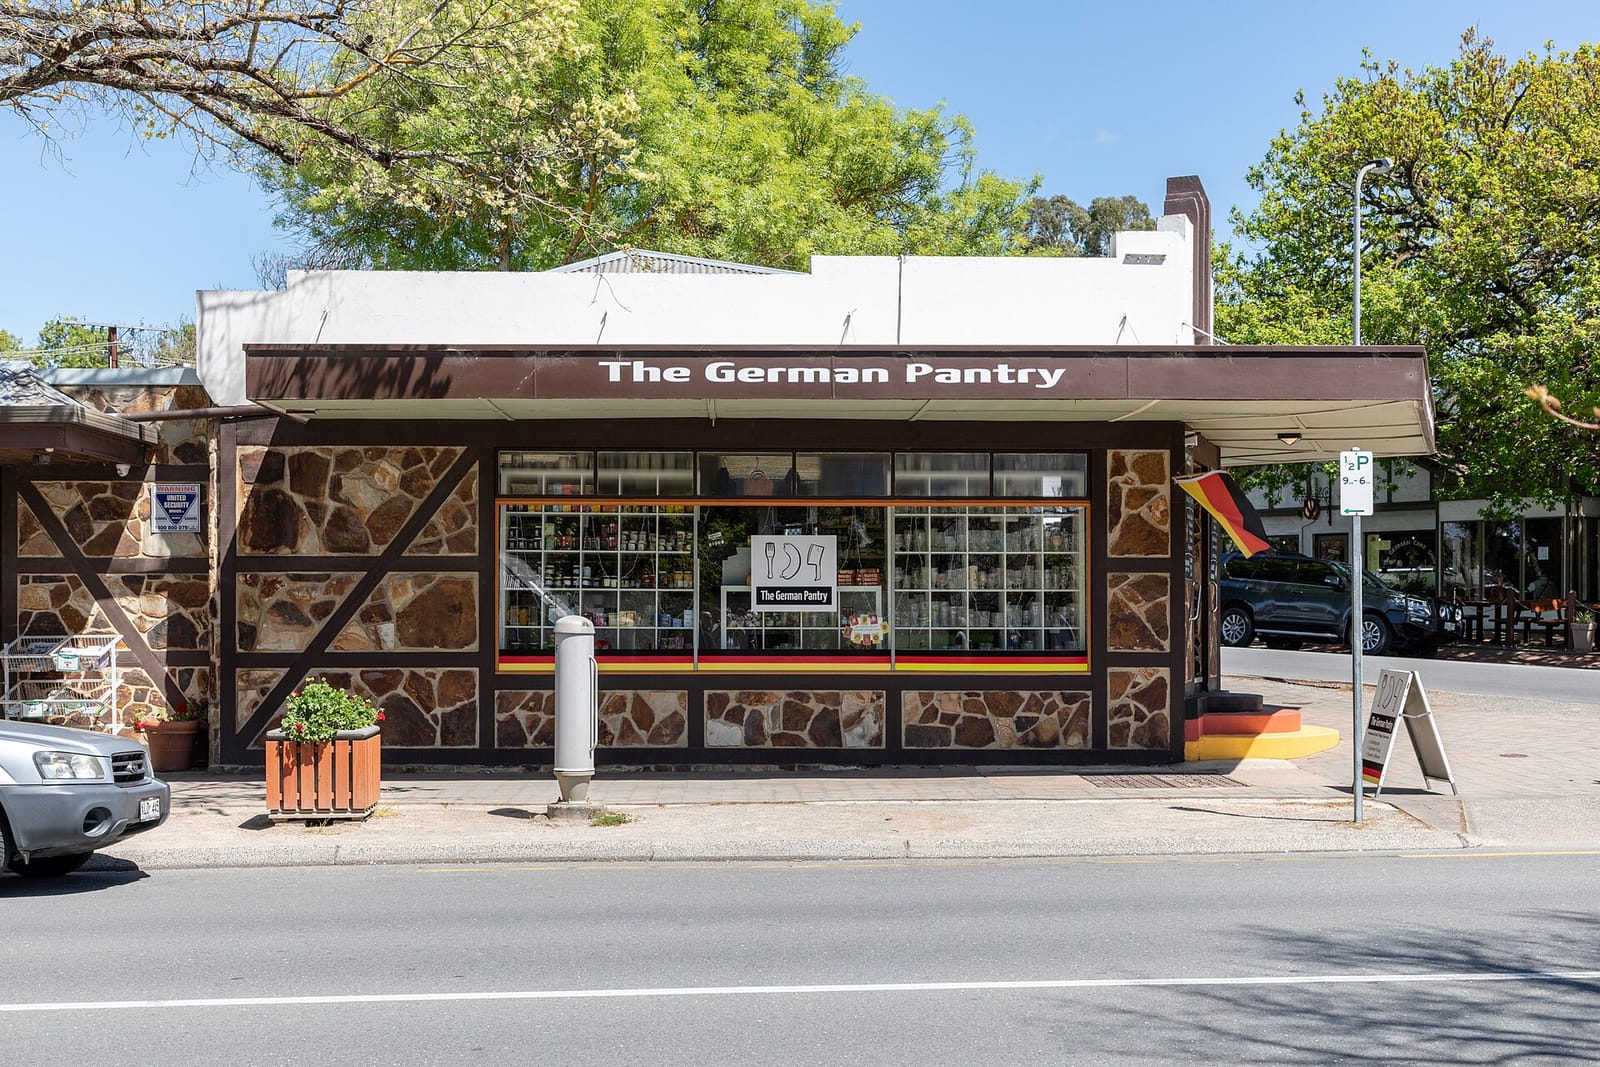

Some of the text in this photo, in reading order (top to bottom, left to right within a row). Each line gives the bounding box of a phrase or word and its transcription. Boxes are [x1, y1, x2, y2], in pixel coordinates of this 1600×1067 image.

[598, 361, 1066, 388] The German Pantry
[163, 501, 190, 509] SECURITY
[760, 590, 828, 603] The German Pantry
